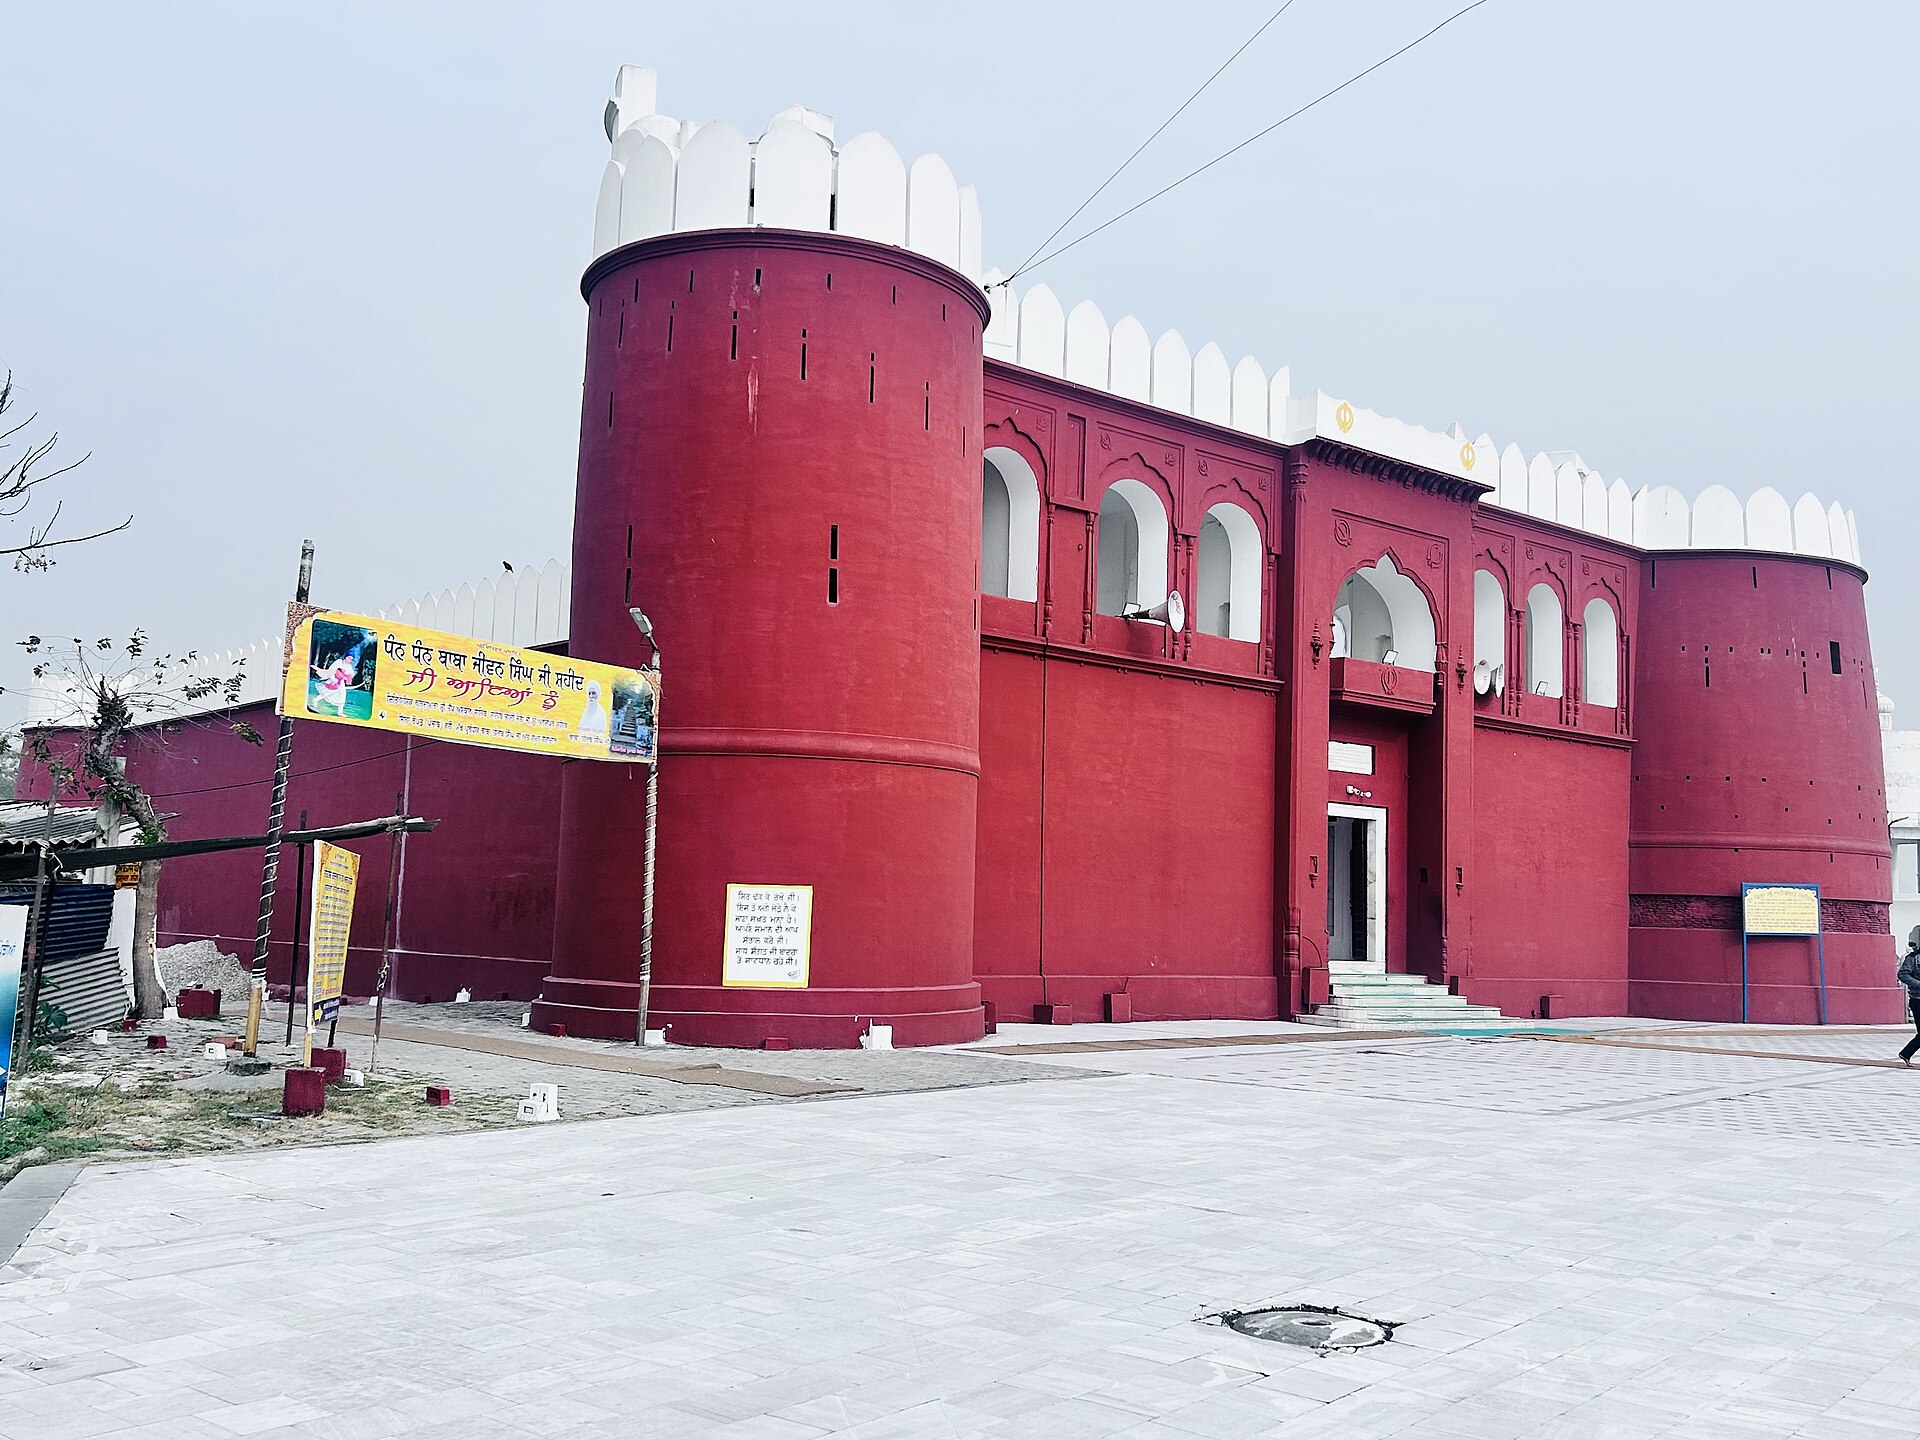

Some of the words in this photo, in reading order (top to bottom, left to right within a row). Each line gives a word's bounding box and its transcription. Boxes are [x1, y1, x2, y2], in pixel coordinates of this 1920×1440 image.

[384, 634, 406, 661] ਧੰਨ
[411, 640, 433, 666] ਧੰਨ
[438, 650, 467, 672] ਬਾਬਾ
[472, 651, 505, 679] ਜੀਵਨ
[509, 657, 534, 685] ਸਿੰਘ
[538, 664, 551, 688] ਜੀ
[555, 668, 584, 692] ਸ਼ਹੀਦ
[402, 668, 437, 692] ਜੀ
[446, 677, 533, 707] ਆਇਆਂ
[541, 691, 559, 711] ਨੂੰ
[745, 957, 771, 965] ਸਾਵਧਾਨ
